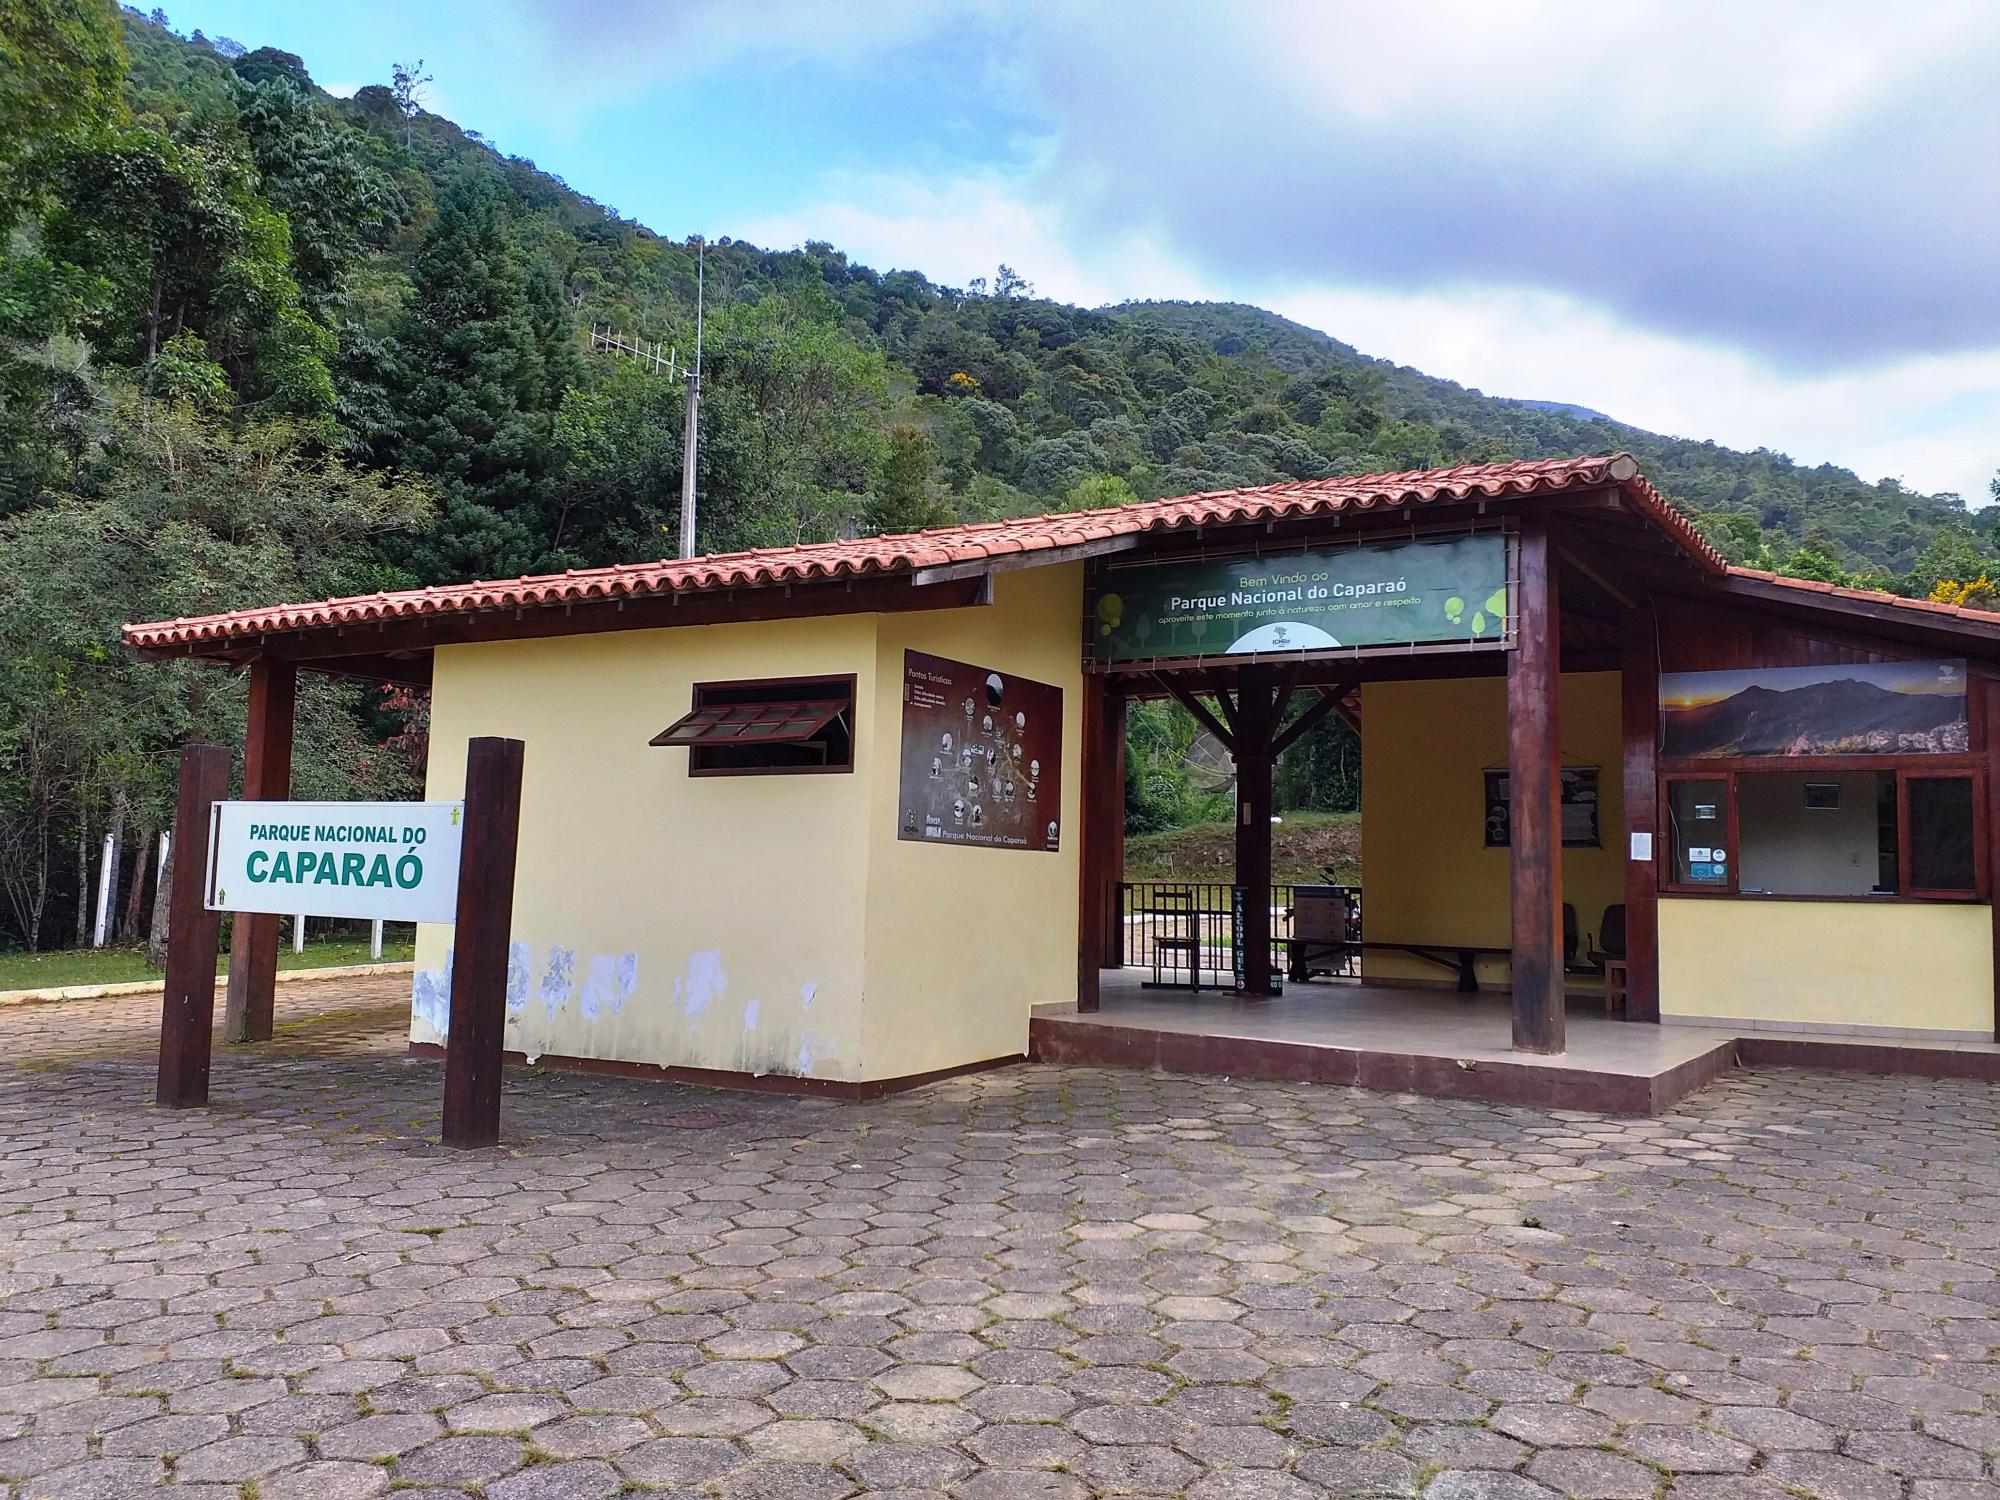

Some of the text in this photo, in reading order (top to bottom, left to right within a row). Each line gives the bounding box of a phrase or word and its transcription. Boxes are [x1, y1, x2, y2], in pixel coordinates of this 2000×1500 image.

[1240, 572, 1329, 588] Bem Vindo ao
[1171, 577, 1407, 611] Parque Nacional do Caparaó
[1158, 613, 1195, 625] aproveite
[1196, 613, 1214, 621] este
[1215, 610, 1254, 620] momento
[1255, 608, 1276, 618] junto
[1287, 604, 1326, 614] natureza
[1327, 603, 1347, 611] com
[1349, 601, 1373, 610] amor
[1383, 596, 1421, 607] respeito
[908, 668, 927, 680] Pontos
[249, 824, 427, 845] PARQUE NACIONAL DO
[942, 829, 965, 841] Parque
[965, 832, 993, 842] Nacional
[994, 835, 1002, 843] do
[246, 846, 423, 890] CAPARAÓ
[1236, 949, 1244, 971] GEL
